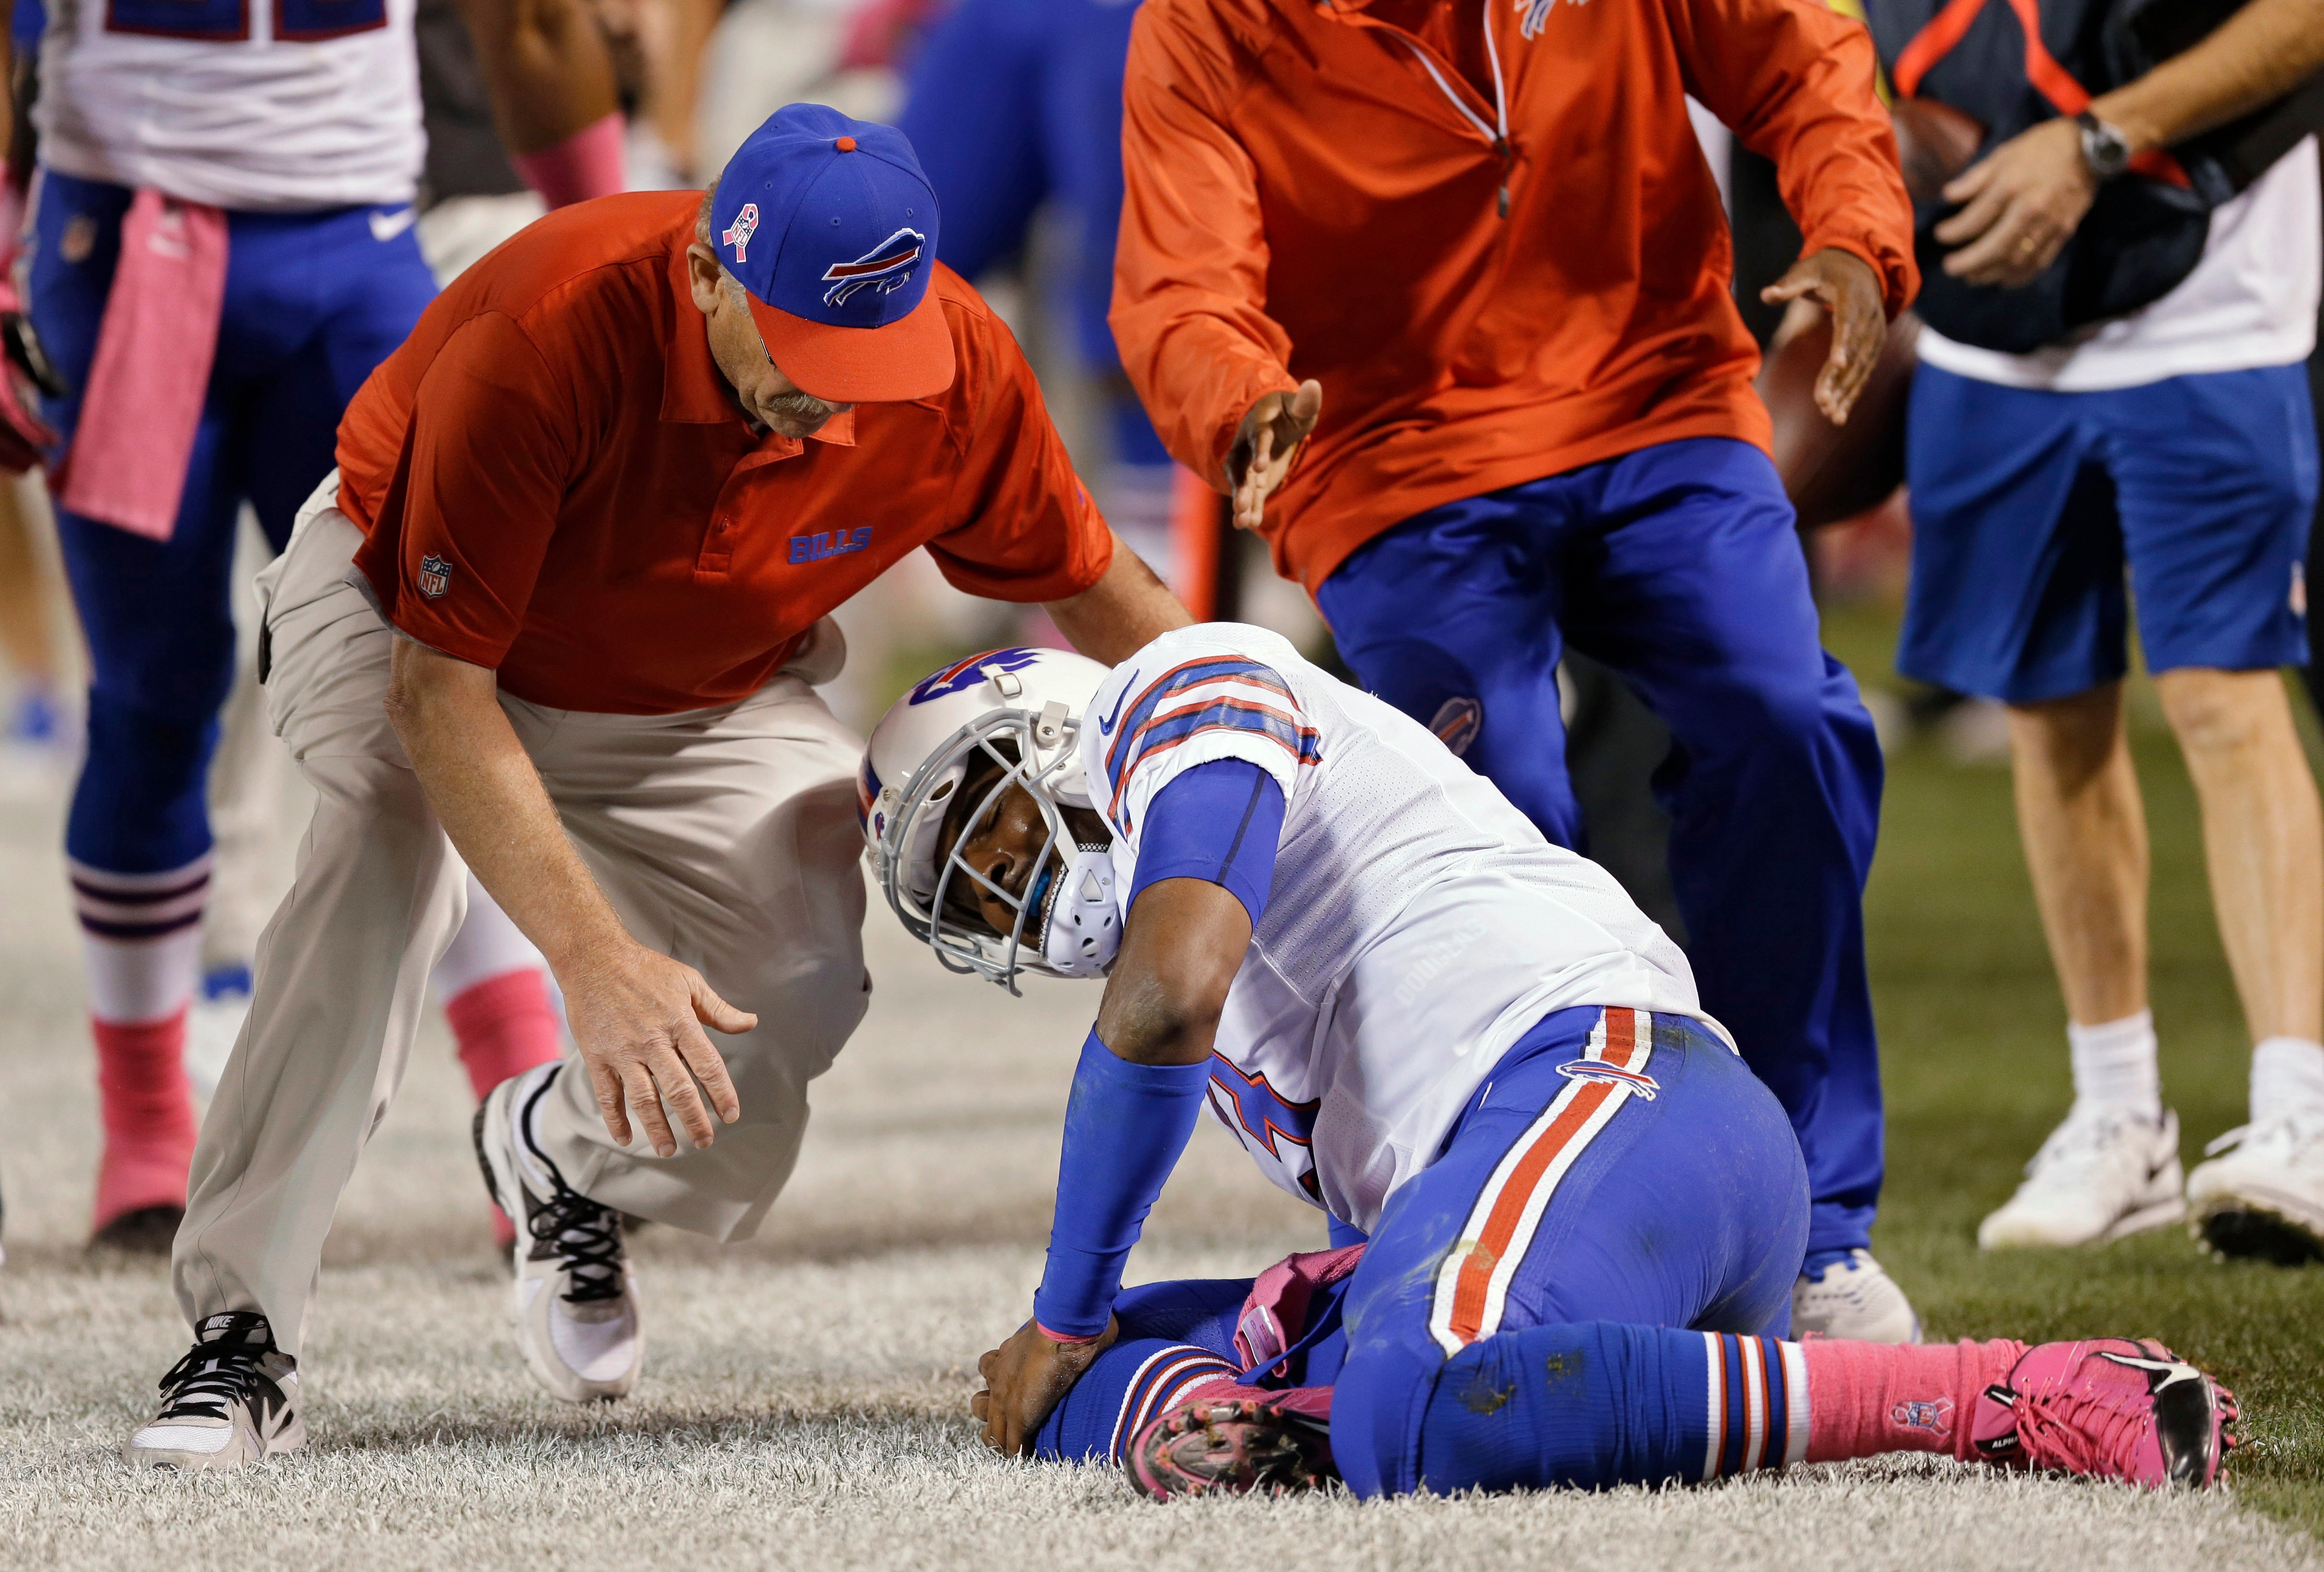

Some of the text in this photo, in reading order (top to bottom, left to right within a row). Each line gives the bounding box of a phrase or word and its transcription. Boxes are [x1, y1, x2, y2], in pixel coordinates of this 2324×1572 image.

[733, 223, 746, 244] NFL
[788, 526, 873, 564] BILLS
[421, 571, 444, 593] NFL
[205, 1315, 235, 1330] NIKE
[1992, 1436, 2018, 1449] ALPHA
